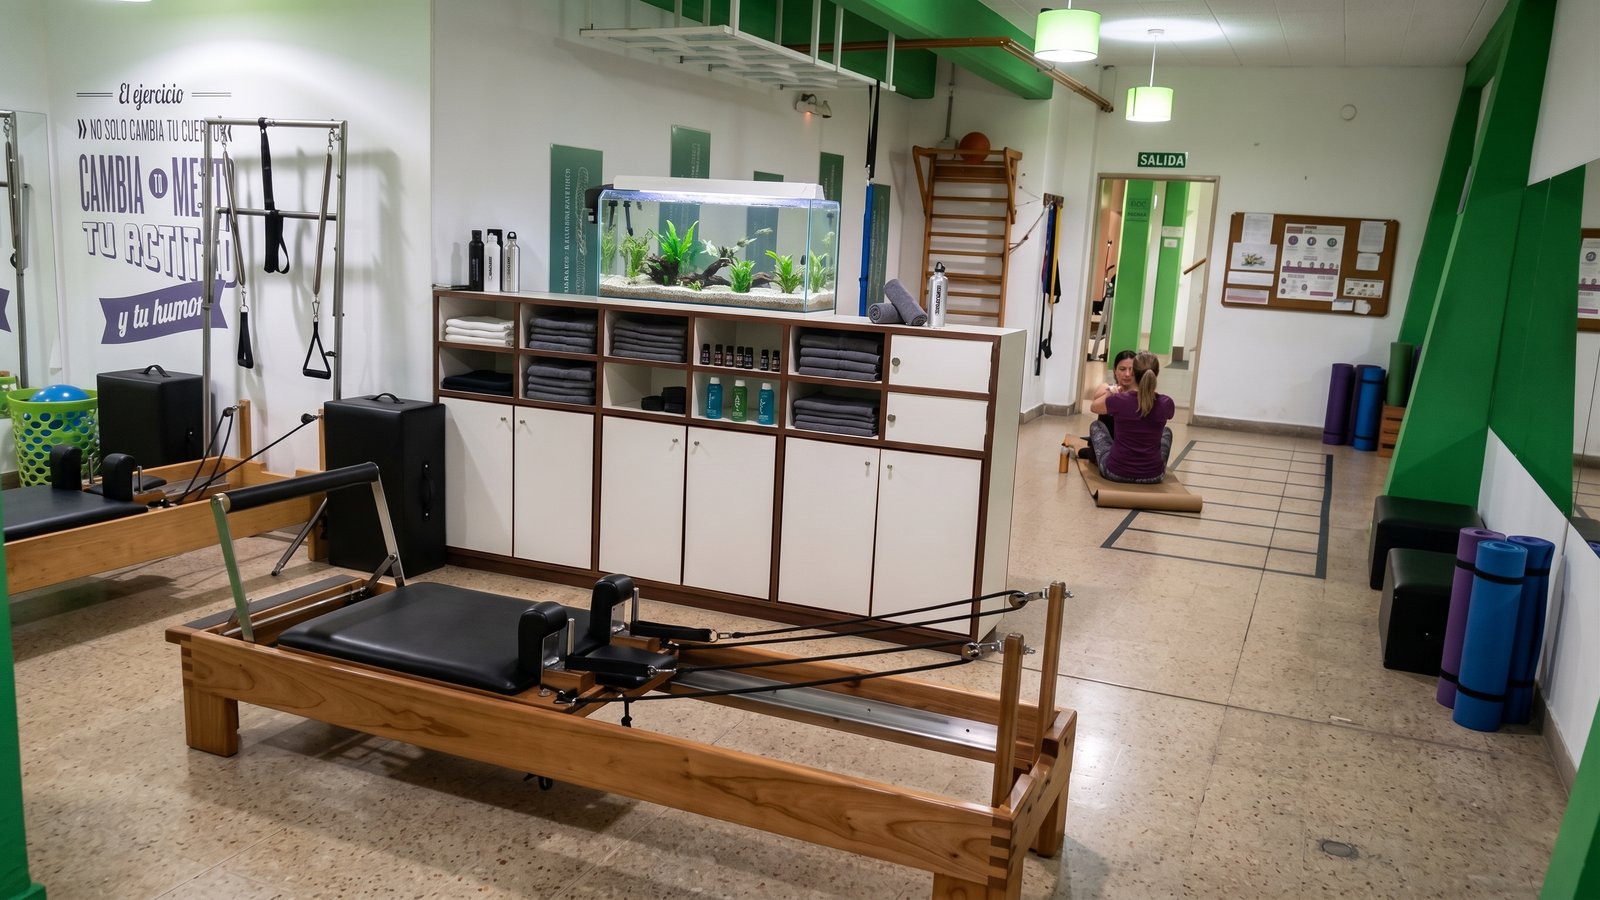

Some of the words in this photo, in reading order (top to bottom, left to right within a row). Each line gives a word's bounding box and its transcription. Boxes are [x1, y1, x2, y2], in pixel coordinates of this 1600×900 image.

[118, 82, 130, 104] El
[133, 83, 184, 110] ejercicio
[90, 119, 102, 140] NO
[104, 119, 127, 141] SOLO
[129, 119, 165, 141] CAMBIA
[166, 120, 179, 141] TU
[1140, 154, 1184, 166] SALIDA
[79, 153, 145, 214] CAMBIA
[82, 221, 116, 259] TU
[124, 223, 238, 288] ACTITD
[118, 311, 129, 337] y
[133, 304, 149, 329] tu
[152, 296, 204, 326] humor
